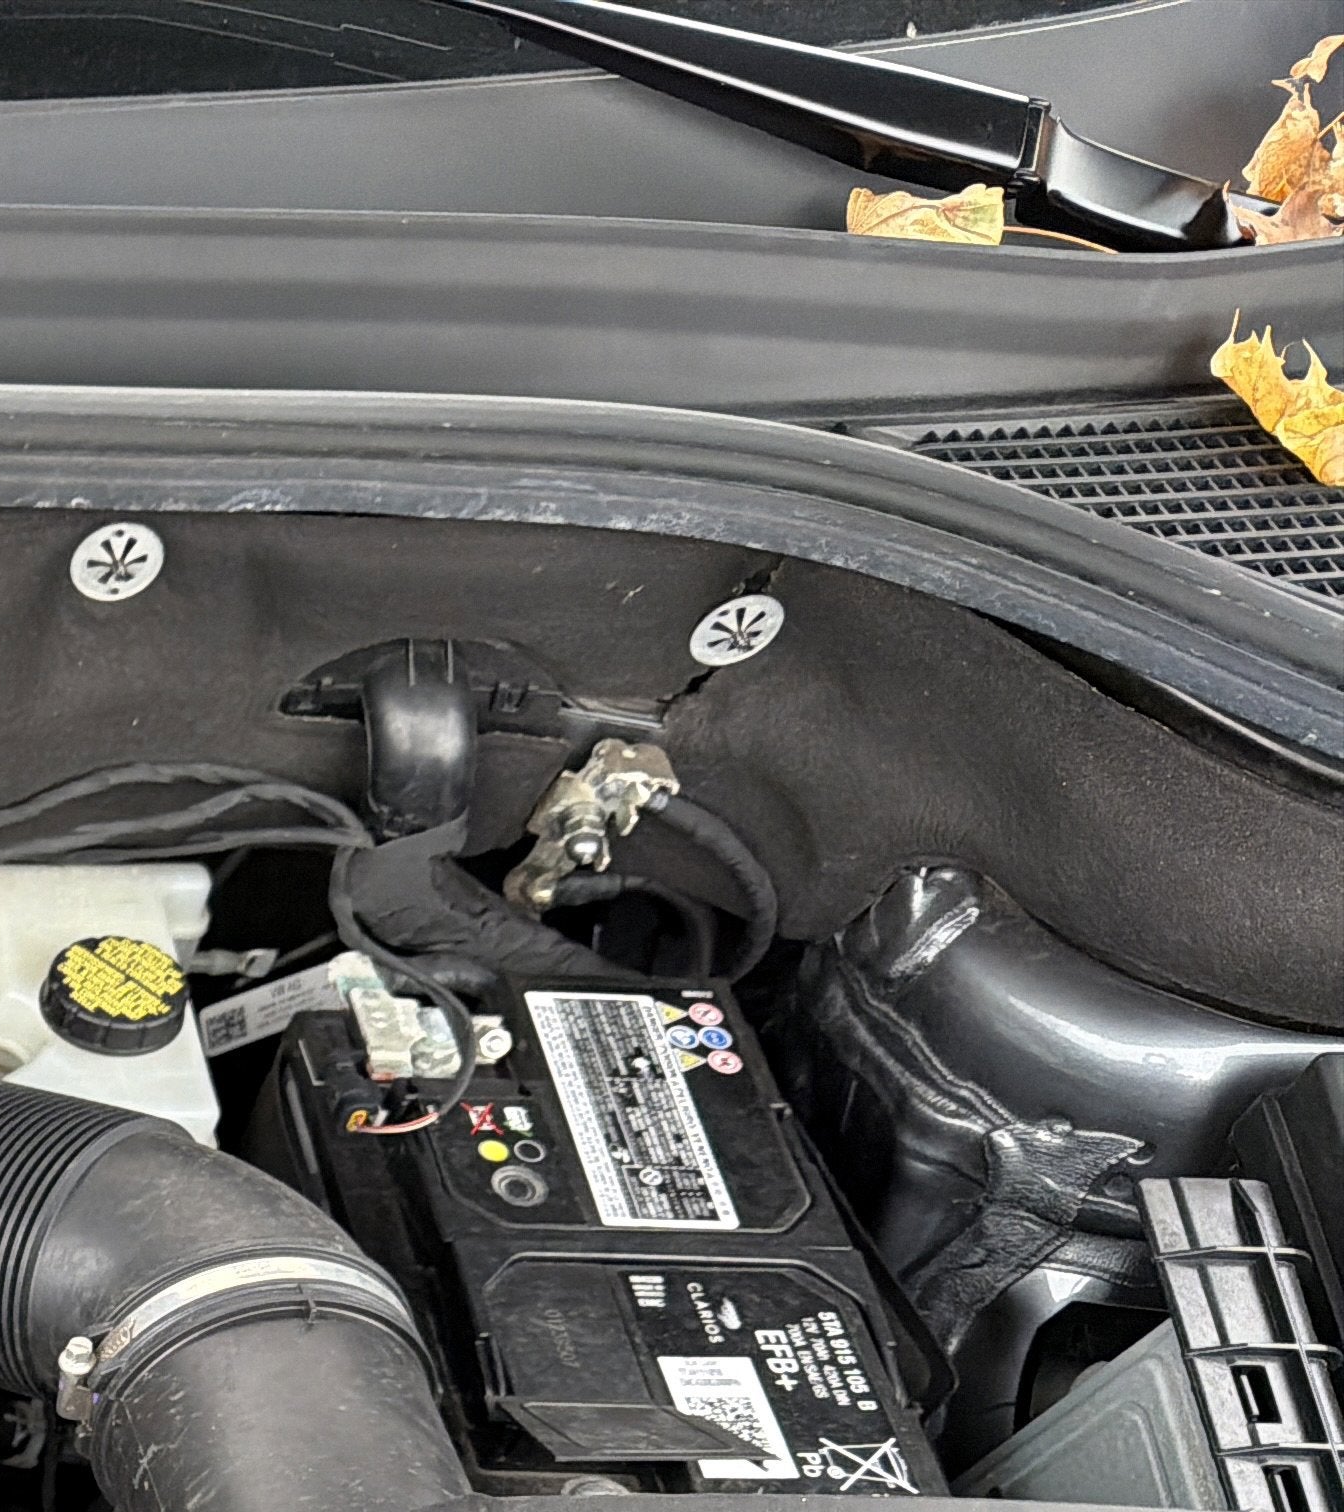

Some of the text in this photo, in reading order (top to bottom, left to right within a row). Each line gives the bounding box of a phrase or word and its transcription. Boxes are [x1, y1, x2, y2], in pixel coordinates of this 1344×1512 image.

[687, 1282, 725, 1344] CLARIOS
[754, 1330, 799, 1391] EFB+
[817, 1311, 879, 1410] 5TA 915 105 B
[797, 1452, 822, 1477] Pb
